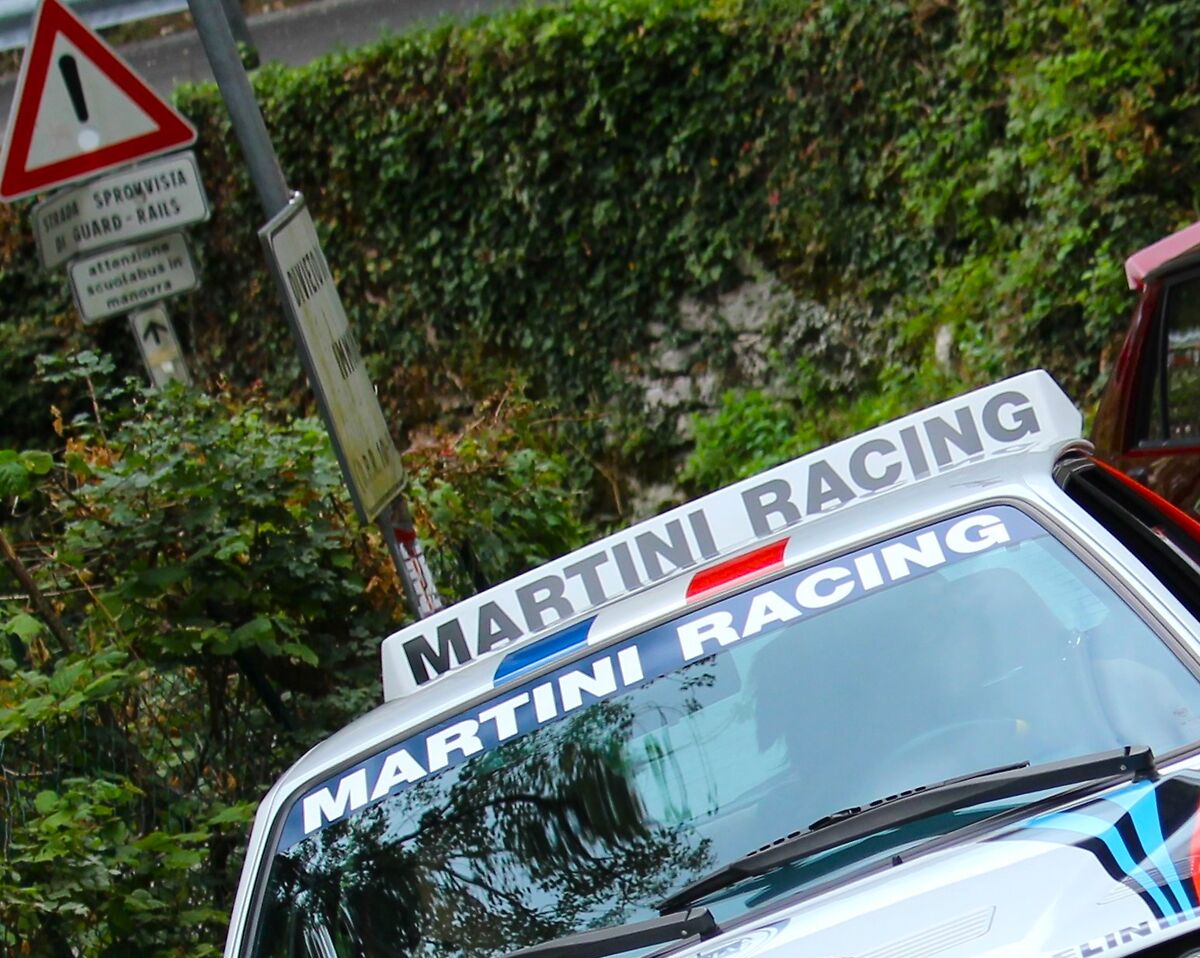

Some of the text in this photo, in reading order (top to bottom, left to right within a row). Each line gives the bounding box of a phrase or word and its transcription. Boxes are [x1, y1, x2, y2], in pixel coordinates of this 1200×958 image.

[304, 513, 1012, 834] MARTINI RACING
[403, 390, 1040, 686] MARTINI RACING
